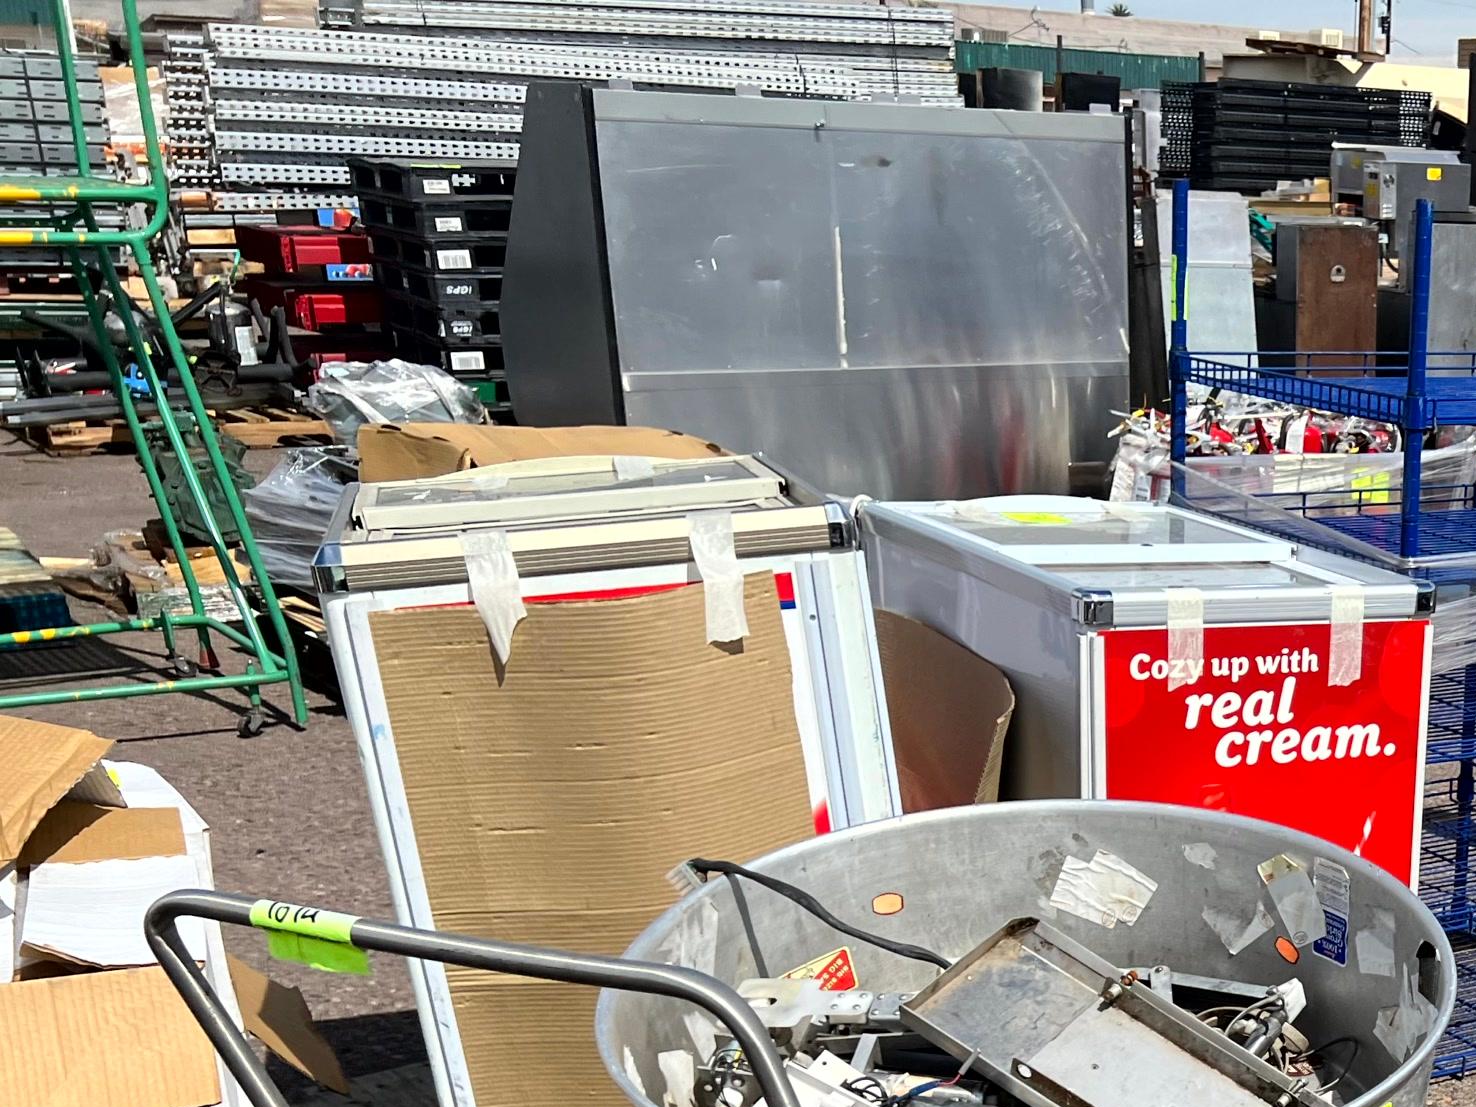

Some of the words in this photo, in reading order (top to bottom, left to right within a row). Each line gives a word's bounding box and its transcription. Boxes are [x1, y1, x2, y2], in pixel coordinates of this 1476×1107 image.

[1129, 652, 1204, 685] Cozy
[1210, 655, 1250, 683] up
[1255, 647, 1319, 675] with
[1184, 676, 1297, 730] real
[1214, 722, 1397, 768] cream.
[267, 901, 320, 924] 1014
